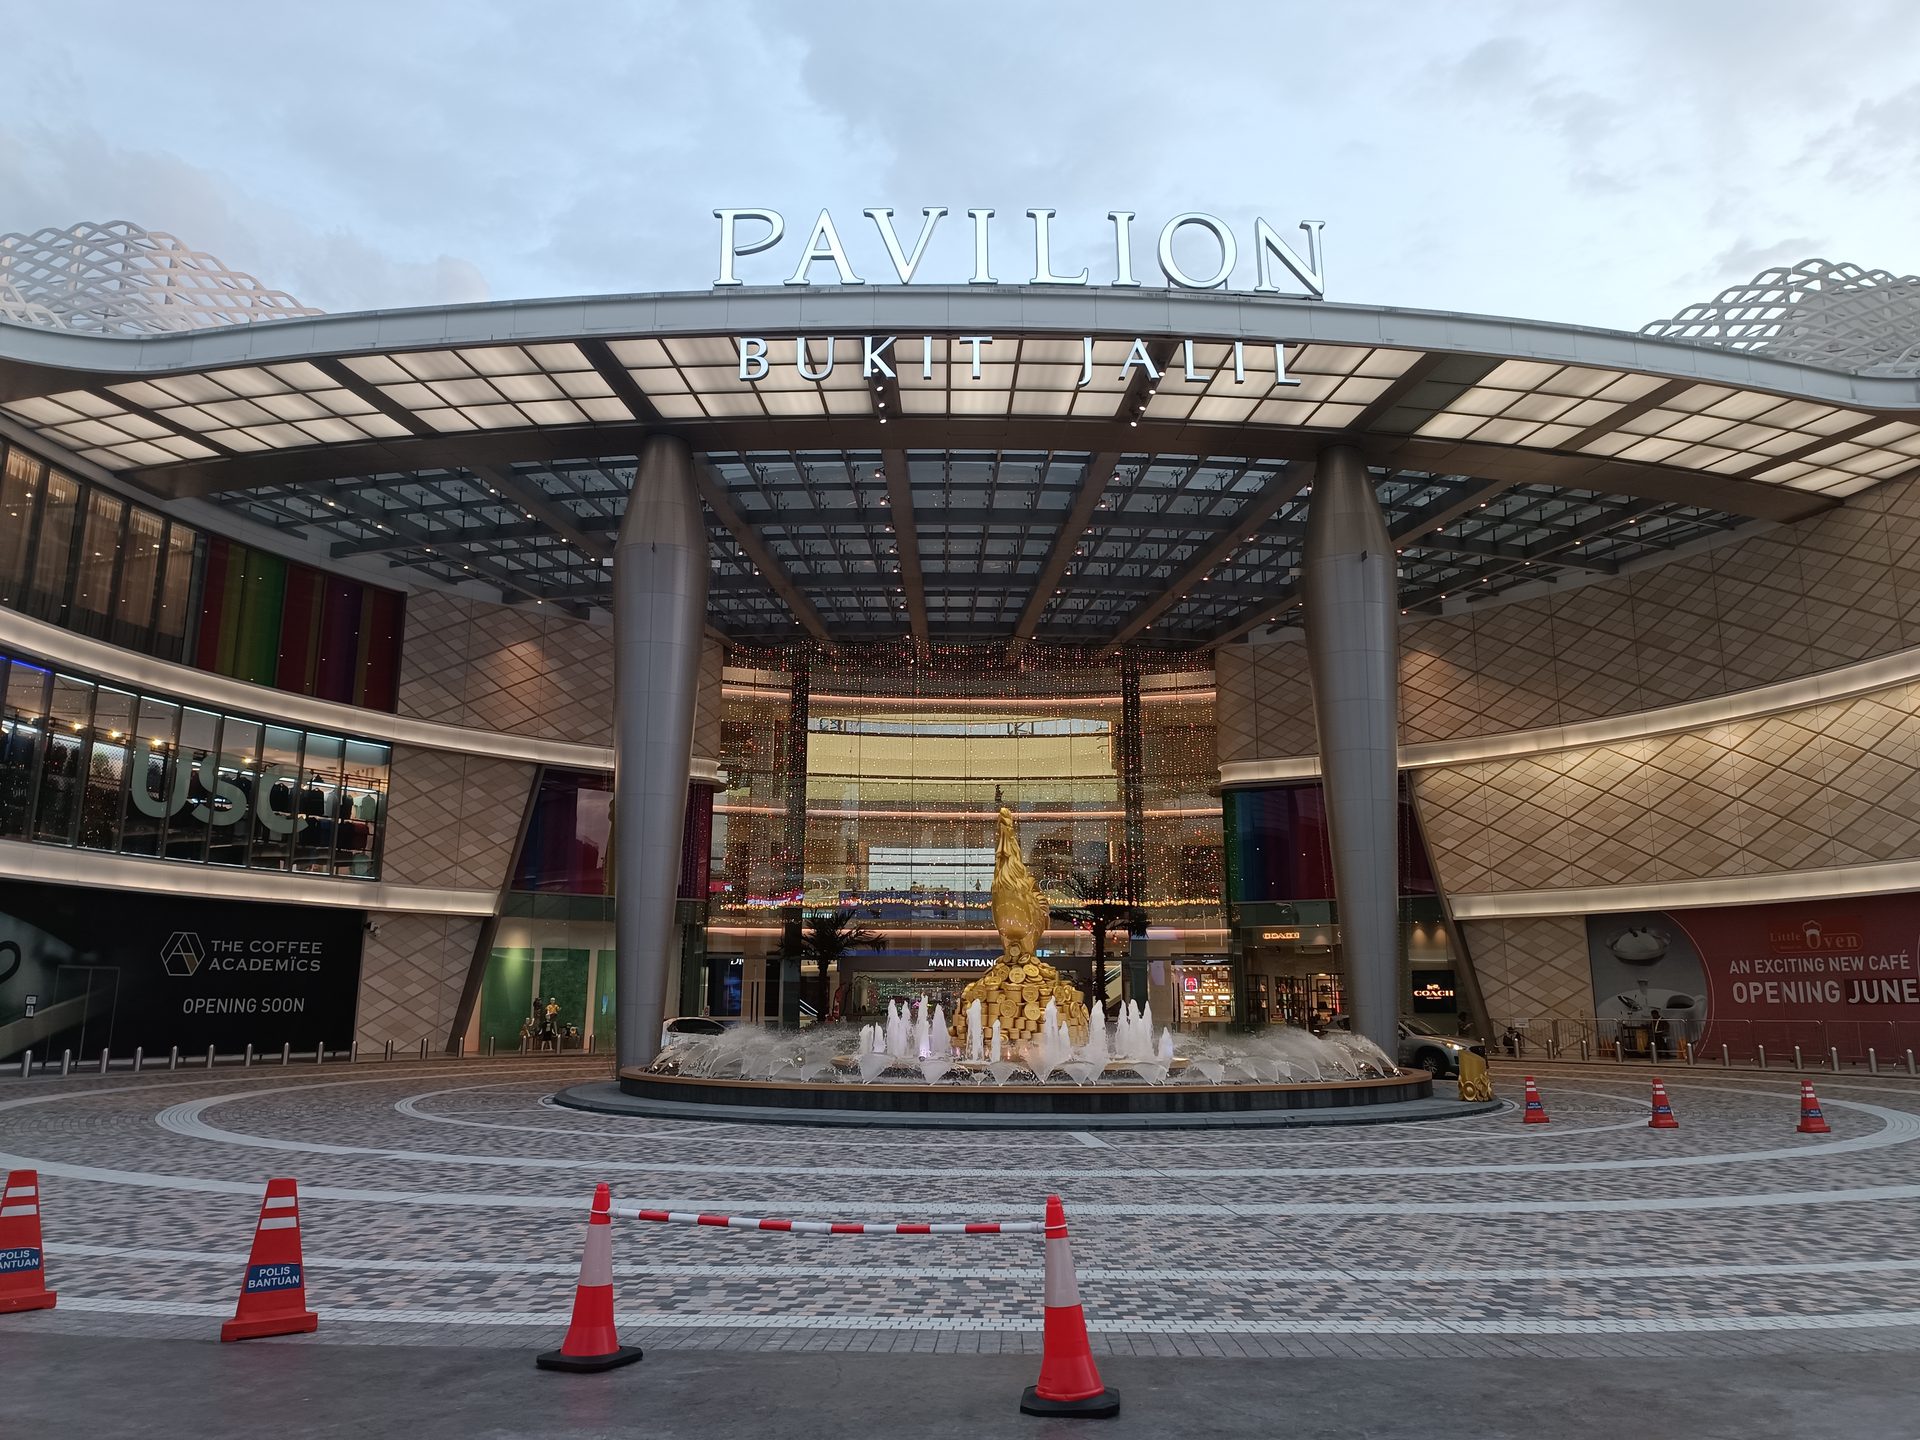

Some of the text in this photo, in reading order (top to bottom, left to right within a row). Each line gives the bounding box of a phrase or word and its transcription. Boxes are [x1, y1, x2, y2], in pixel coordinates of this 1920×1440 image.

[713, 206, 1325, 297] PAVILION
[739, 336, 1302, 387] BUKIT JALIL
[131, 743, 309, 834] USC
[211, 940, 323, 954] THE COFFEE
[208, 956, 321, 972] ACADEMÏCS
[928, 958, 954, 967] MAIN
[1729, 949, 1911, 975] AN EXCITING NEW CAFÉ
[1732, 978, 1920, 1005] OPENING JUNE
[182, 997, 305, 1014] OPENING SOON
[0, 1250, 30, 1260] POLIS
[259, 1266, 290, 1278] POLIS
[248, 1275, 300, 1289] BANTUAN
